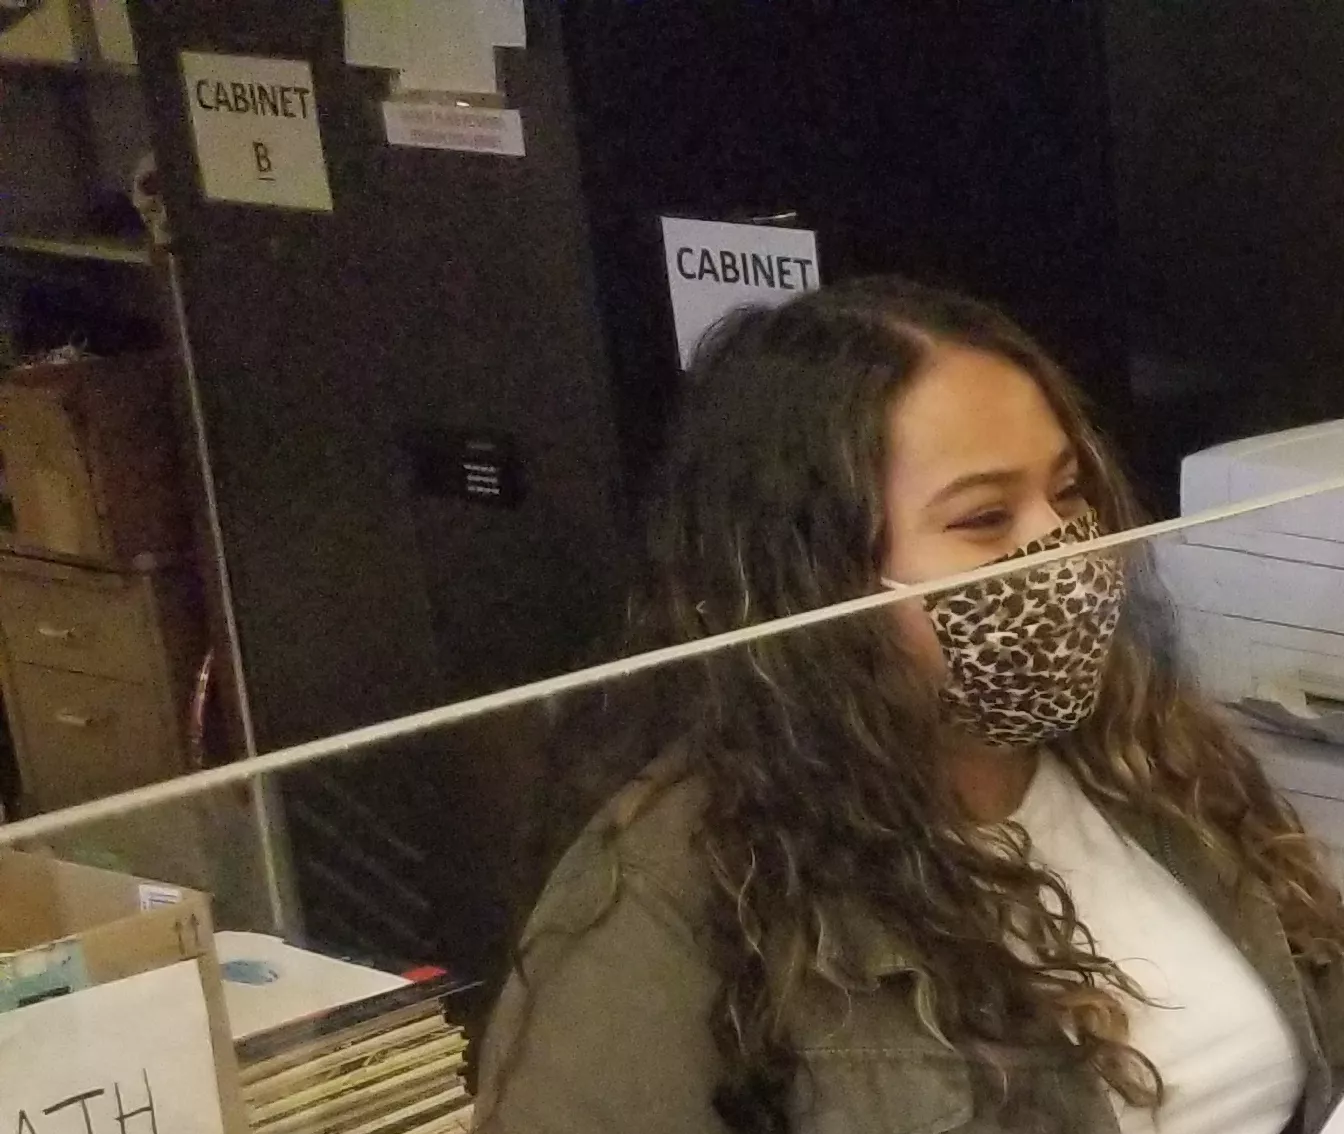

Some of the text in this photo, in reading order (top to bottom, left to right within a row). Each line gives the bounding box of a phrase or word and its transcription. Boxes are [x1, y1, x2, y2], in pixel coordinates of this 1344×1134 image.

[196, 79, 311, 119] CABINET
[253, 142, 273, 173] B
[676, 246, 813, 291] CABINET
